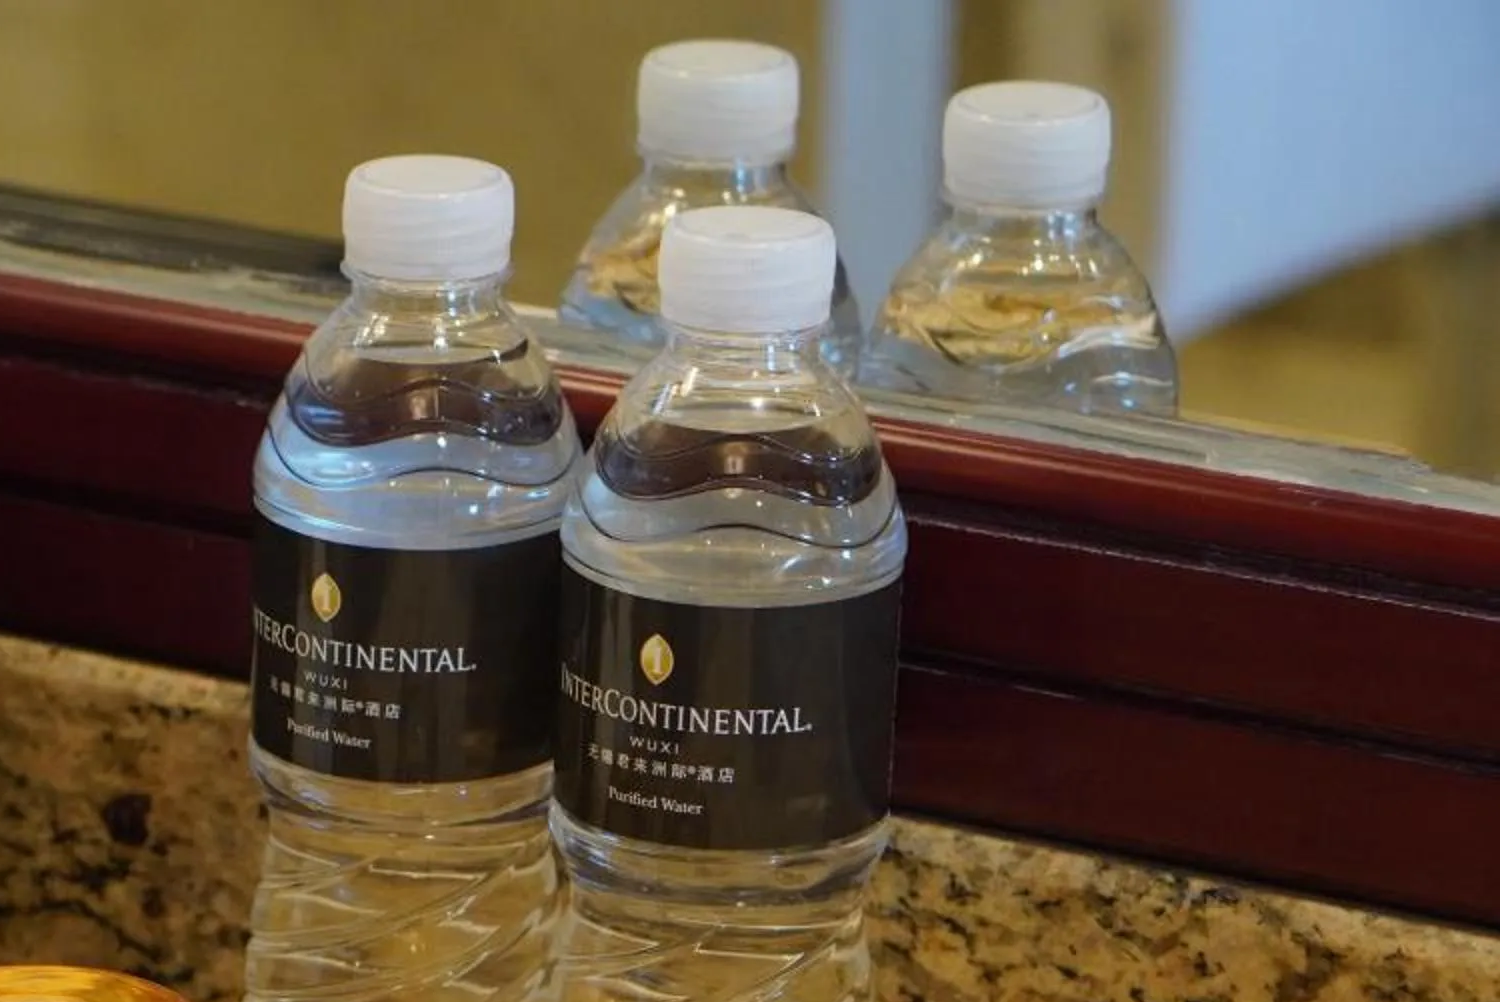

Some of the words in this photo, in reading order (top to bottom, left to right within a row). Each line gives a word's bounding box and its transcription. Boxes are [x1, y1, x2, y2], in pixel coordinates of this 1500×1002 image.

[253, 605, 477, 673] TERCONTINENTAL.
[303, 670, 348, 690] WUXI
[332, 729, 372, 749] Water
[629, 735, 680, 755] WUXI
[608, 785, 658, 809] Purified
[660, 796, 704, 815] Water
